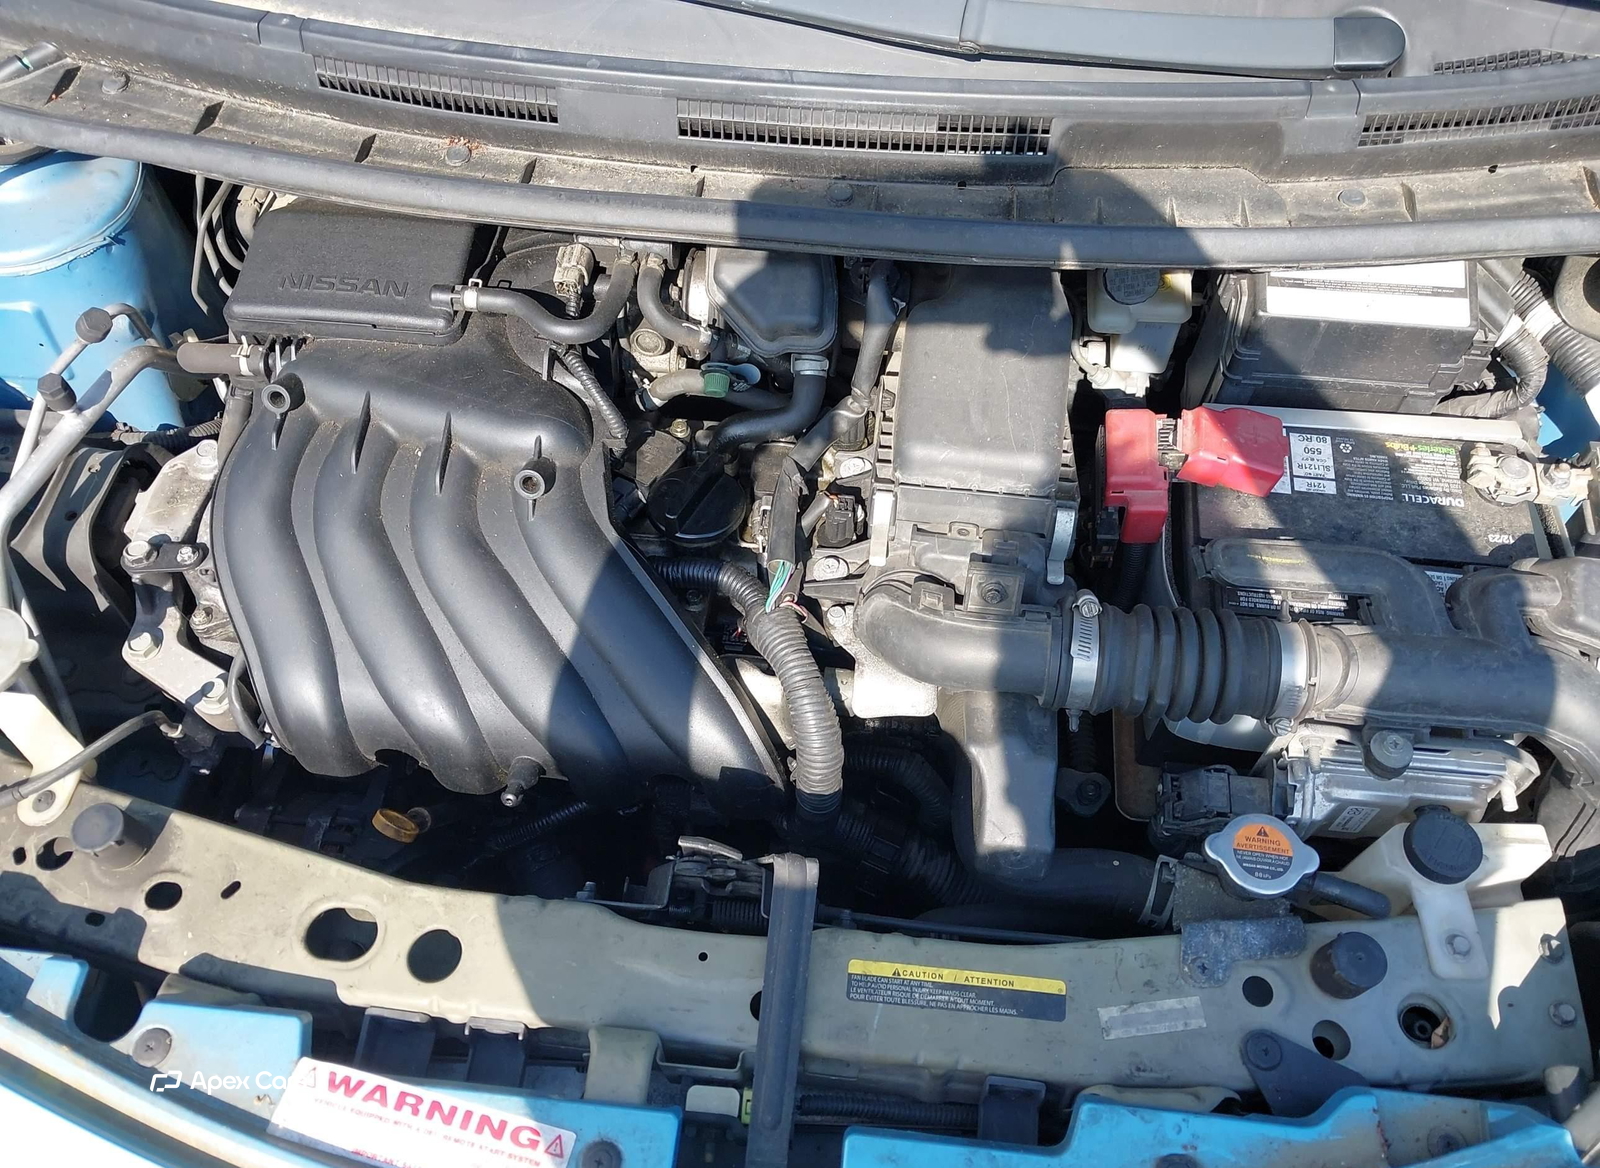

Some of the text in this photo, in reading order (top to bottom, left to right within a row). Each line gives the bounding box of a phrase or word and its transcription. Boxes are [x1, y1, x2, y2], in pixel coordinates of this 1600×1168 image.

[279, 273, 410, 299] NISSAN
[1316, 436, 1327, 444] 80
[1304, 447, 1322, 455] 550
[1297, 462, 1330, 472] SLI121R
[1306, 481, 1326, 489] 121R
[1402, 493, 1465, 508] DURACELL
[1244, 836, 1280, 846] WARNING
[1236, 842, 1289, 854] AVERTISSEMENT
[902, 970, 943, 980] CAUTION
[964, 975, 1014, 988] ATTENTION
[858, 987, 891, 997] VENTILATEUR
[892, 991, 911, 999] RISQUE
[871, 982, 887, 990] AVOID
[888, 984, 912, 992] PERSONAL
[943, 989, 960, 997] HANDS
[850, 992, 865, 1000] POUR
[885, 996, 901, 1004] TOUTE
[956, 1003, 988, 1013] APPROCHER
[327, 1070, 542, 1152] WARNING
[350, 1107, 390, 1125] EQUIPPED
[507, 1151, 540, 1168] SYSTEM
